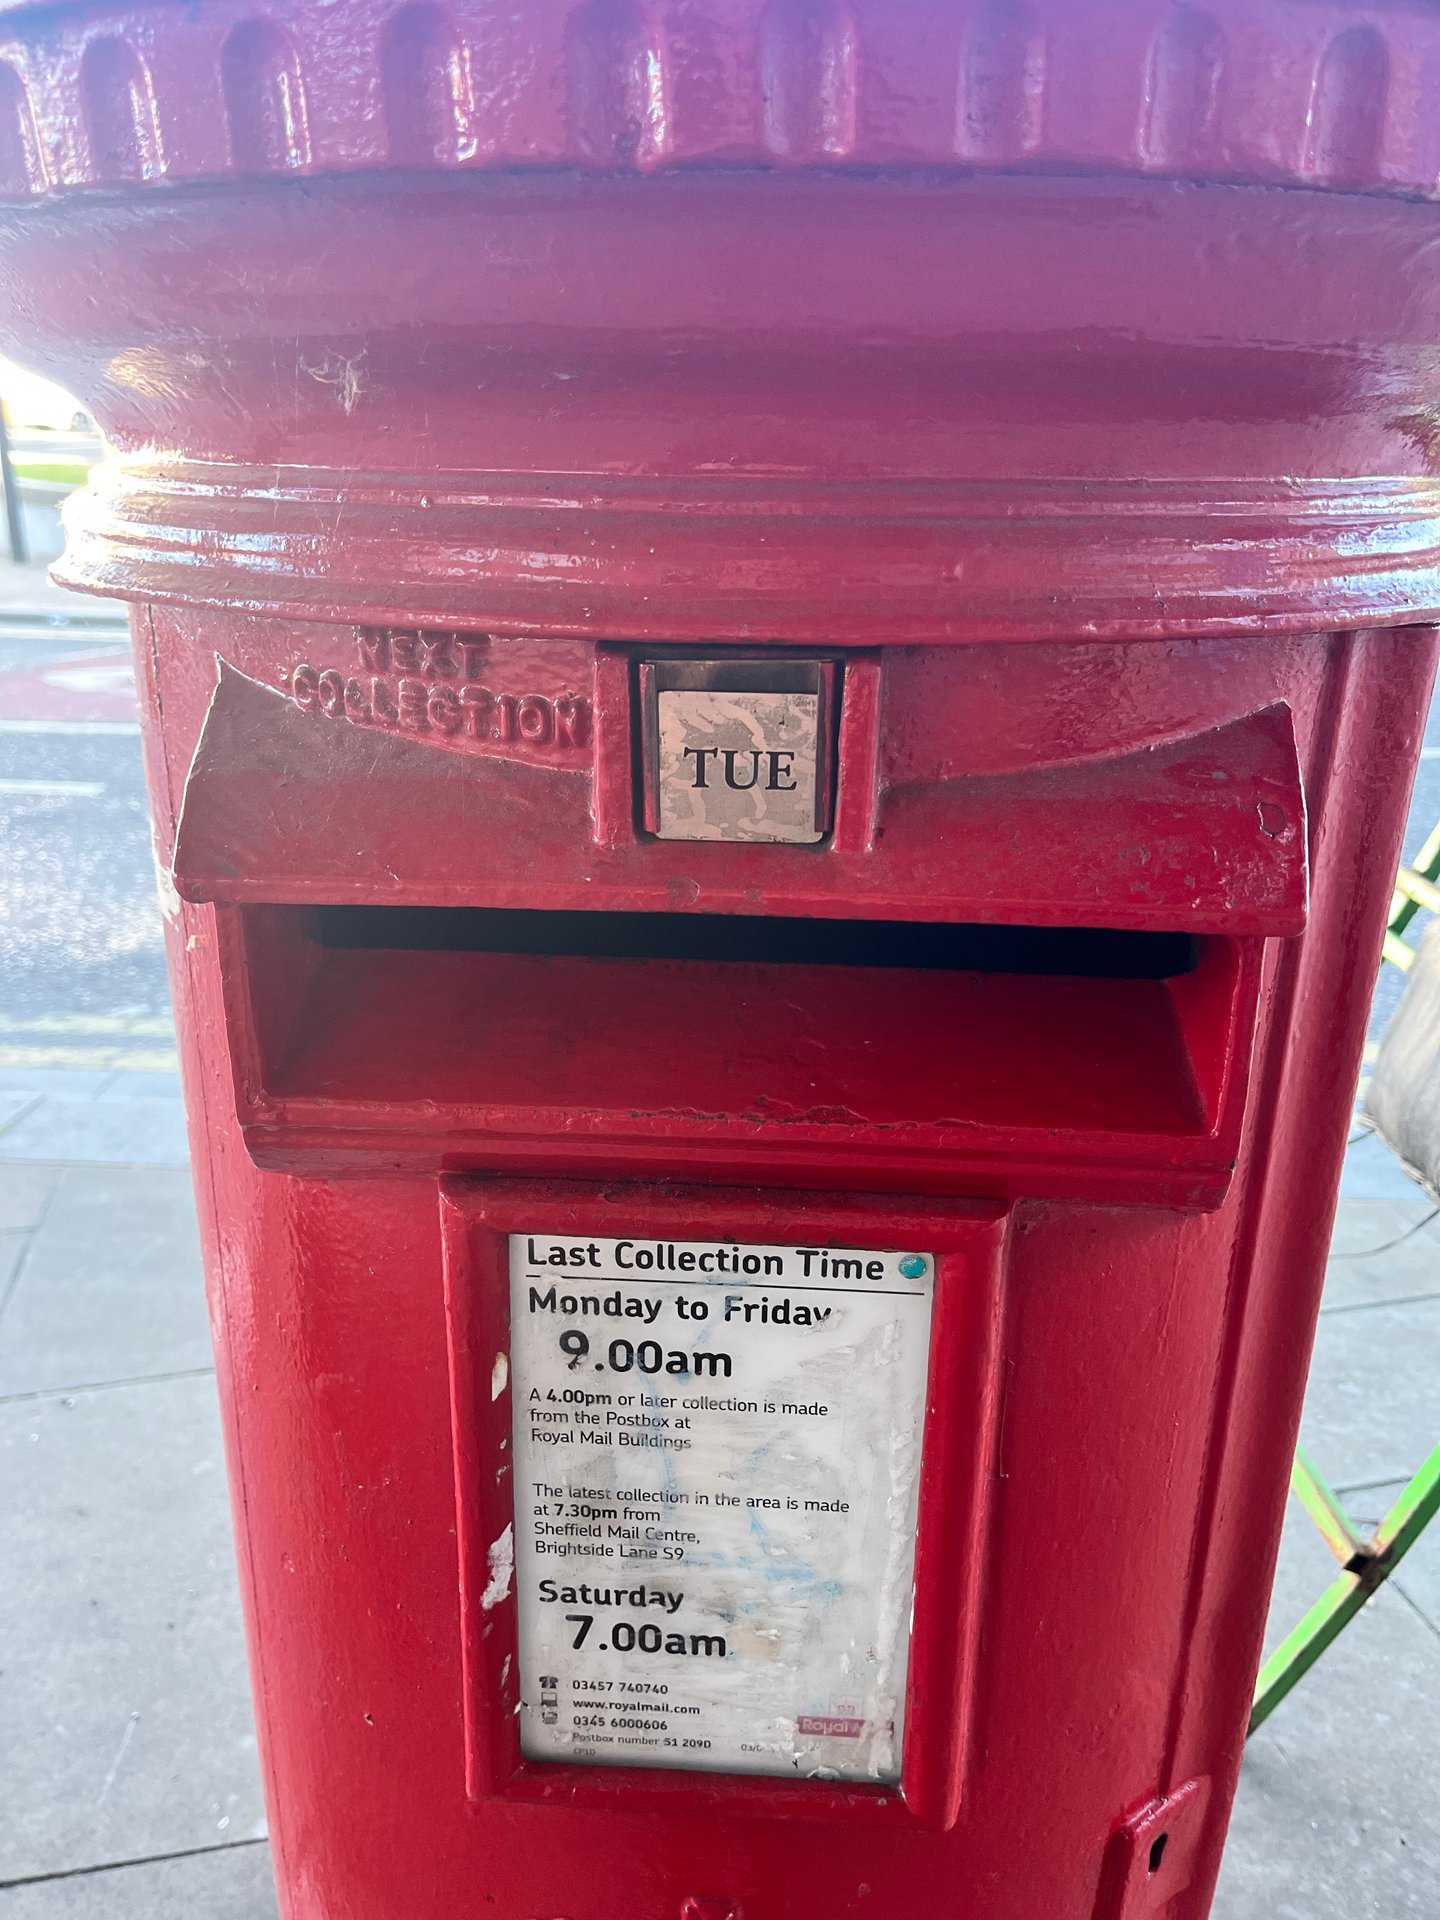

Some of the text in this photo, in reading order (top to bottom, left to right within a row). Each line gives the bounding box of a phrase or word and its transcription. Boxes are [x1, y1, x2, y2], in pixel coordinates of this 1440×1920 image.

[292, 664, 592, 748] COLLECTION
[683, 746, 798, 791] TUE
[527, 1238, 885, 1280] Last Collection Time
[529, 1286, 663, 1324] Monday
[675, 1296, 709, 1321] to
[559, 1329, 732, 1377] 9.00am
[529, 1388, 828, 1416] A 4.00pm or later collection is made
[530, 1408, 691, 1429] from the Postbox at
[531, 1428, 692, 1451] Royal Mail Buildings
[532, 1483, 850, 1513] The latest collection in the area is made
[533, 1503, 661, 1522] at 7.30pm from
[534, 1522, 701, 1544] Sheffield Mail Centre,
[535, 1540, 685, 1561] Brightside Lane S9
[538, 1579, 684, 1614] Saturday
[565, 1614, 726, 1657] 7.00am
[572, 1680, 668, 1694] 03457 740740
[572, 1699, 700, 1715] www.royalmail.com
[573, 1715, 668, 1731] 0345 6000606
[801, 1718, 849, 1735] Royal
[572, 1732, 614, 1744] Postbox
[618, 1735, 659, 1746] number
